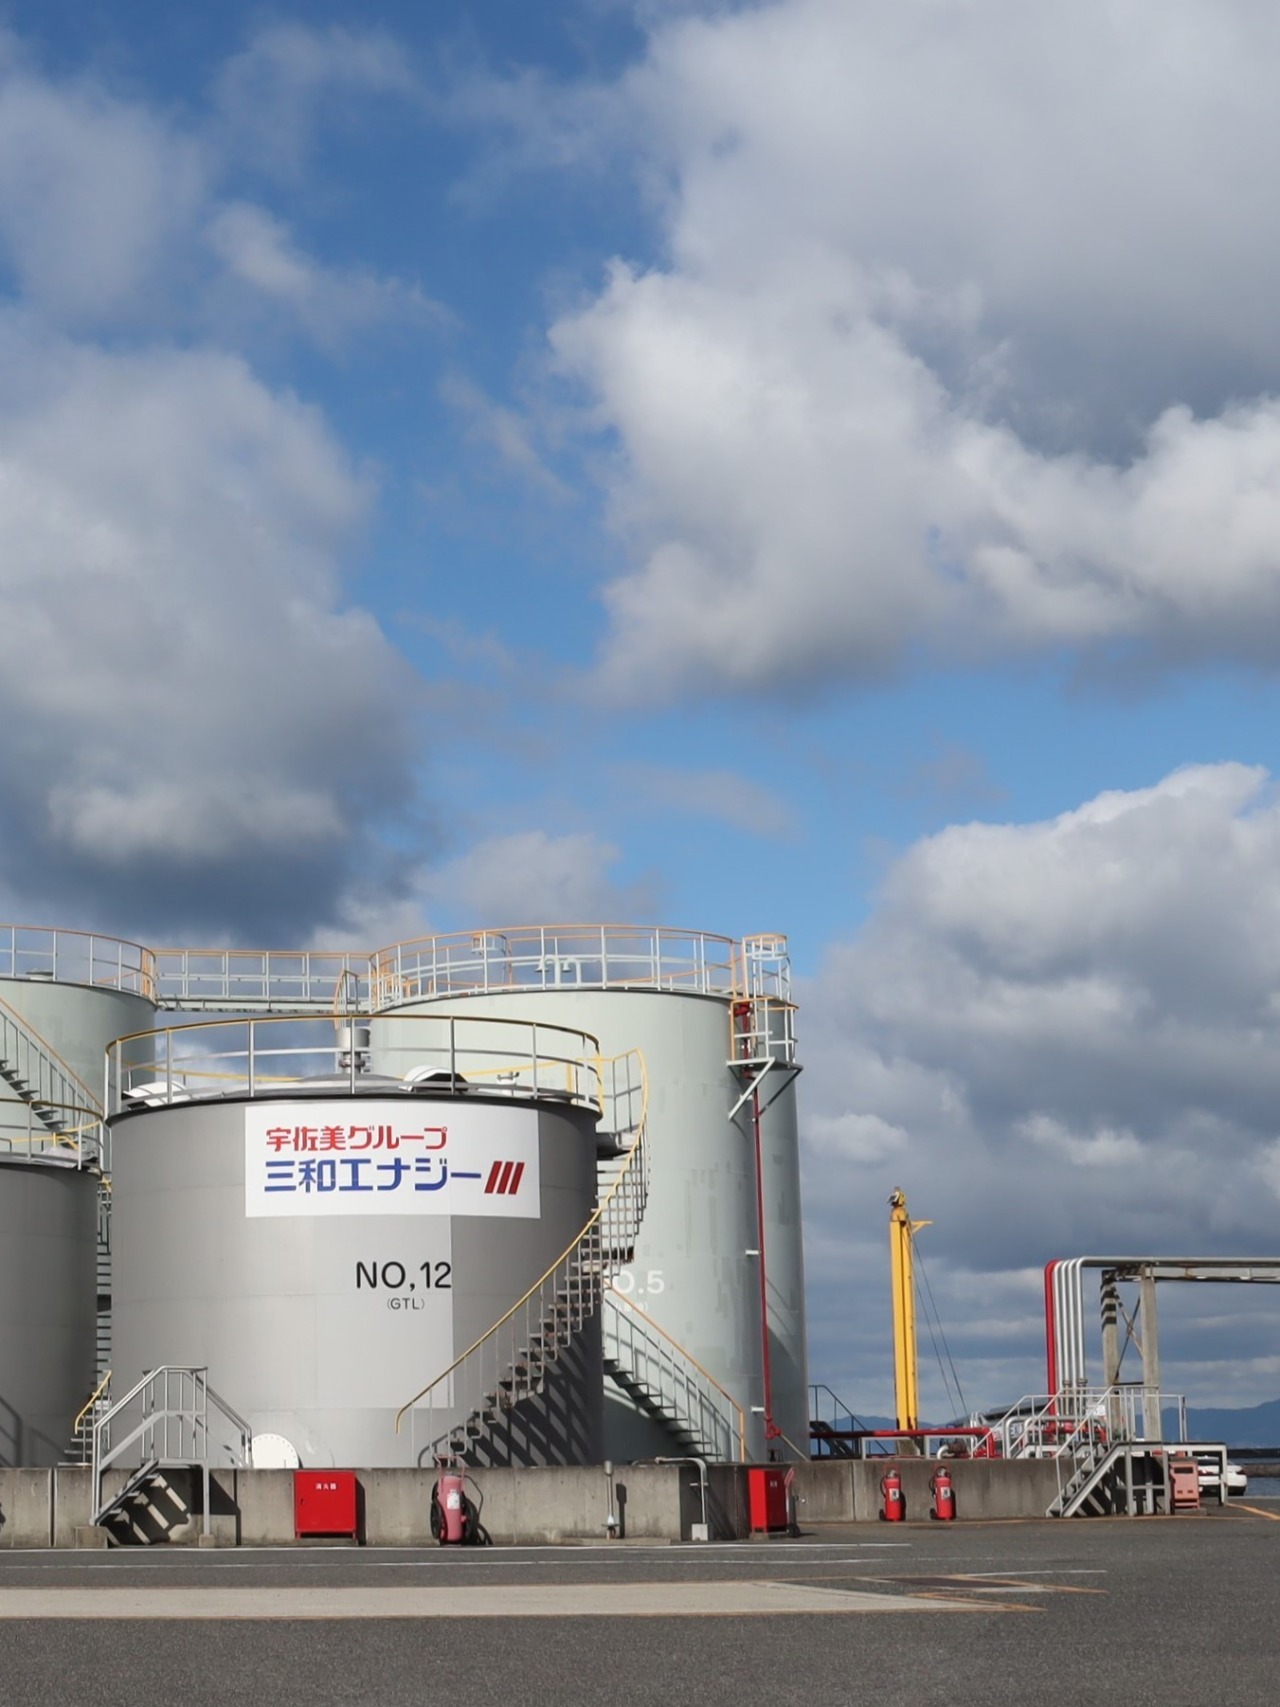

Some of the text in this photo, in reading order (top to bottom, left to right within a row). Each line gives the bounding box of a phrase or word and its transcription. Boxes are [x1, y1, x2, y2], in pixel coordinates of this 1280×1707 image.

[266, 1126, 447, 1151] 宇佐美グループ
[264, 1158, 481, 1193] 三和エナジー
[387, 1298, 425, 1310] (GTL)
